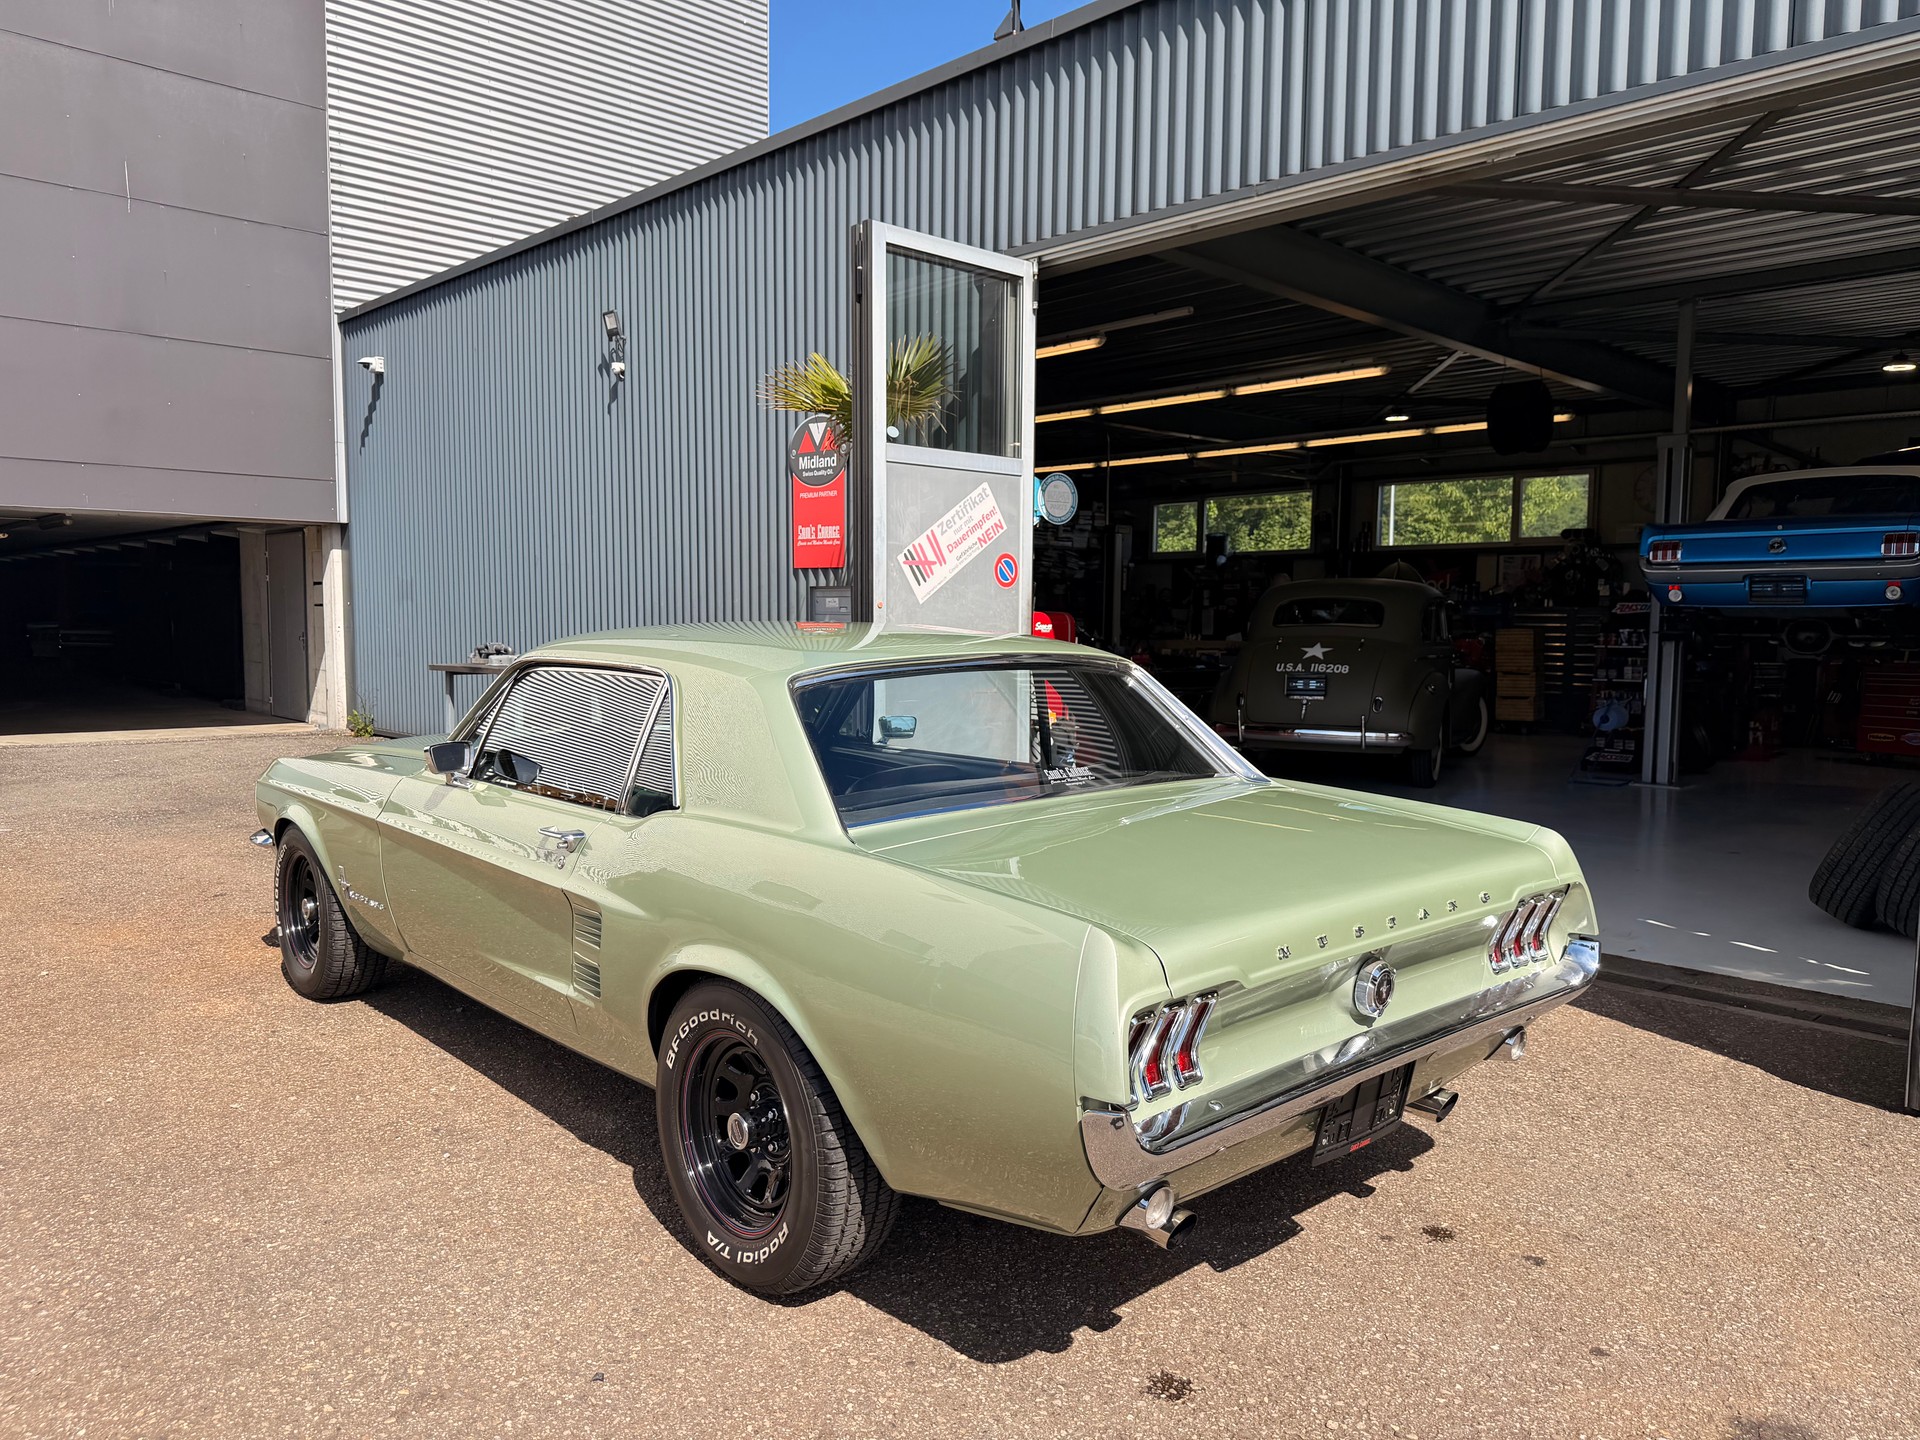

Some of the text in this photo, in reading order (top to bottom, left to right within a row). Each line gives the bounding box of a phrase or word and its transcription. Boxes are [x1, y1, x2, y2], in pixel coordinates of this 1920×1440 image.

[799, 453, 837, 470] Midland
[799, 489, 838, 499] PREMIUM PARTNER
[937, 487, 990, 536] Zertifikat
[946, 506, 998, 554] Dauerimpfen!
[953, 515, 974, 535] nur mit
[976, 519, 1004, 549] NEIN
[1275, 662, 1350, 674] U.S.A. 116208
[1276, 891, 1491, 960] MUSTANG
[665, 1008, 759, 1070] BFGoodrich
[707, 1222, 789, 1265] Radial T/A
